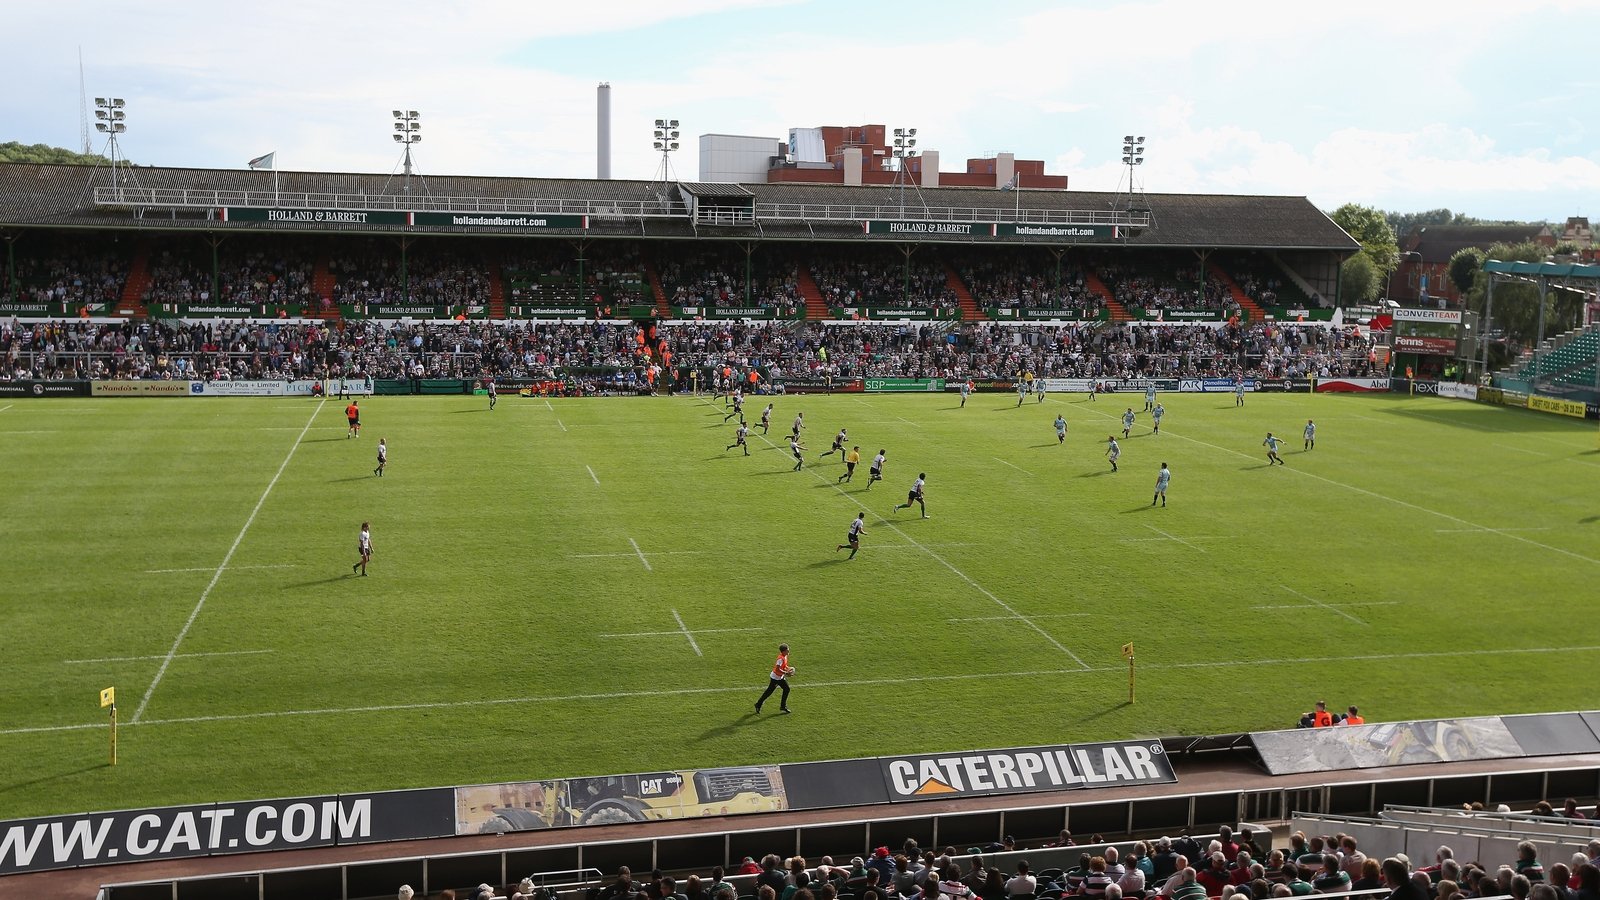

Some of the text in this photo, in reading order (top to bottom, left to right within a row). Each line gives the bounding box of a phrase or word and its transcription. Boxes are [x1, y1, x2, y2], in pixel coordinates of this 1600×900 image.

[268, 210, 367, 223] HOLLAND & BARRETT
[453, 215, 547, 227] hollandandbarrett.com
[890, 222, 972, 234] HOLLAND & BARRETT
[1016, 225, 1095, 236] hollandandbarrett.com
[20, 304, 48, 312] BARRETT
[188, 305, 251, 313] hollandandbarrett.com
[1396, 309, 1459, 319] CONVERTEAM
[1395, 336, 1424, 347] Fenns
[1370, 378, 1388, 388] Abel
[1412, 382, 1438, 394] next
[640, 778, 663, 795] CAT
